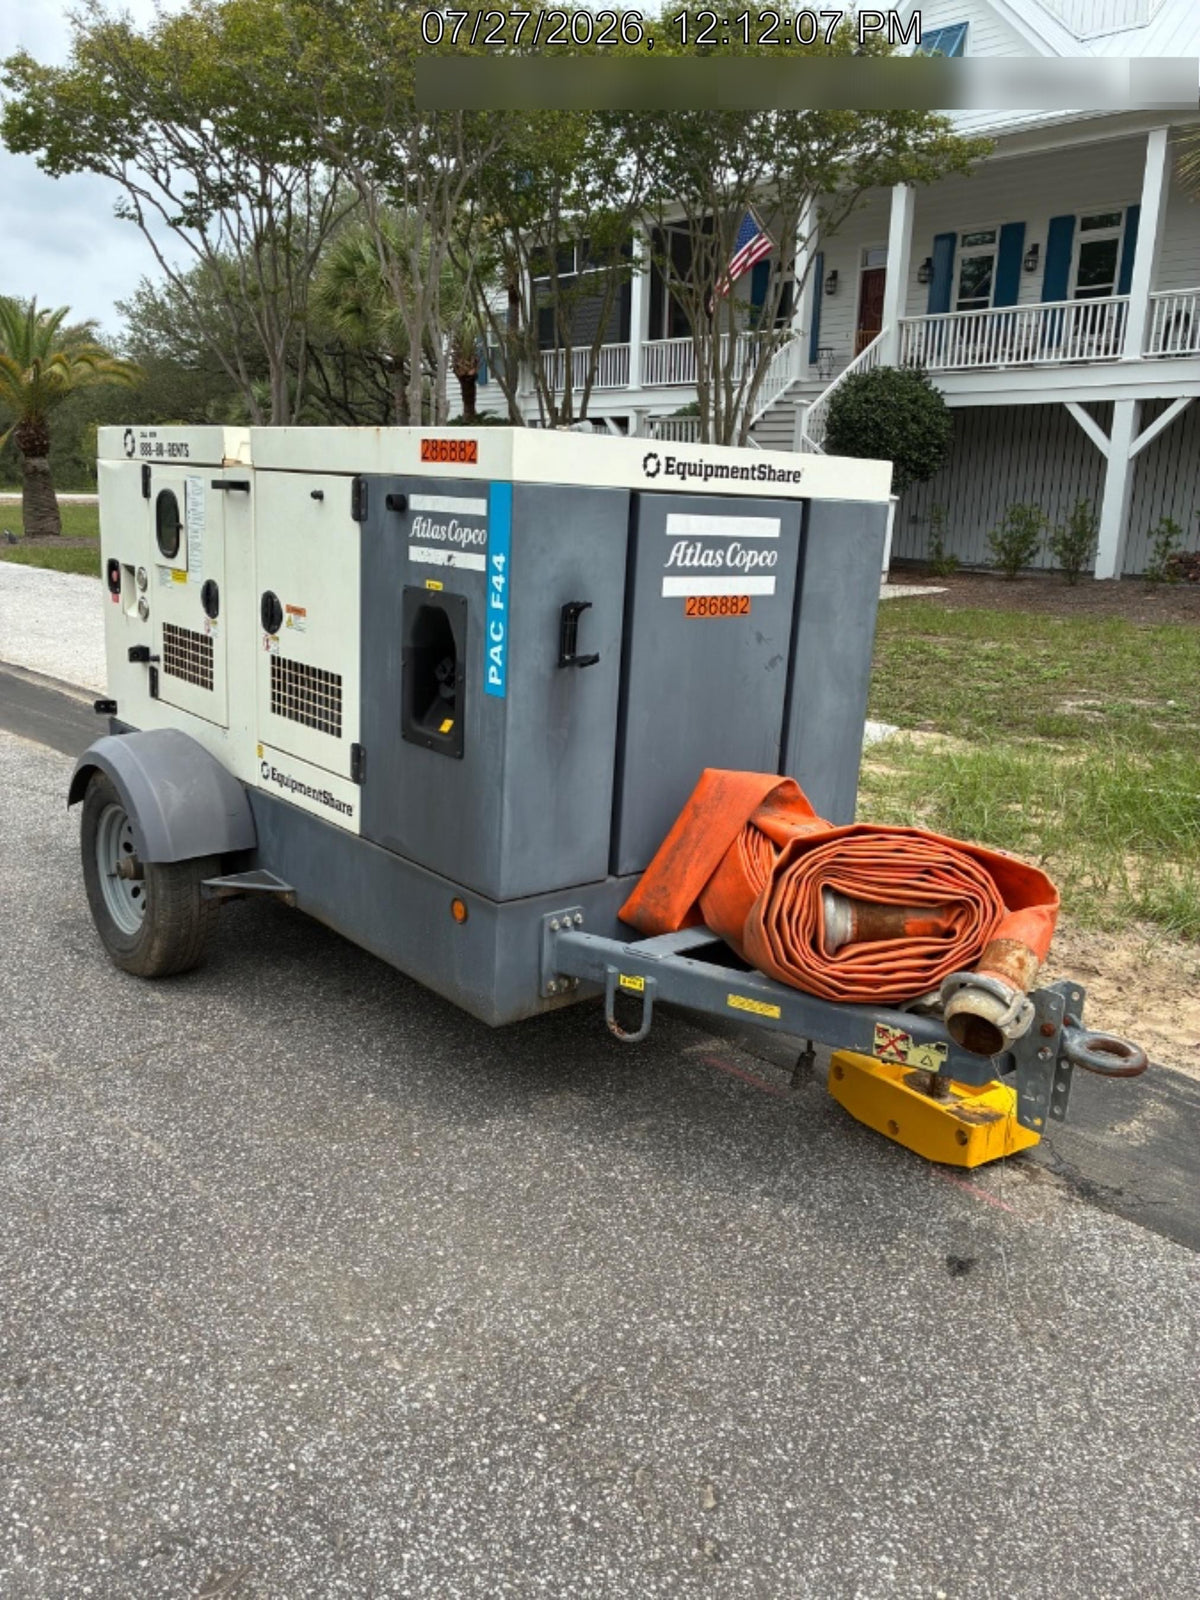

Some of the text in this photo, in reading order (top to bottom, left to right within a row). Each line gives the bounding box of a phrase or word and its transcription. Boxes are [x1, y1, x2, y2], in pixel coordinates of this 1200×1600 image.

[421, 439, 477, 463] 286882
[664, 457, 801, 483] EquipmentShare
[408, 516, 488, 548] Atlas Copco
[664, 540, 778, 573] Atlas Copco
[488, 552, 506, 685] PAC F44
[686, 595, 749, 615] 286882
[271, 767, 353, 815] EquipmentShare
